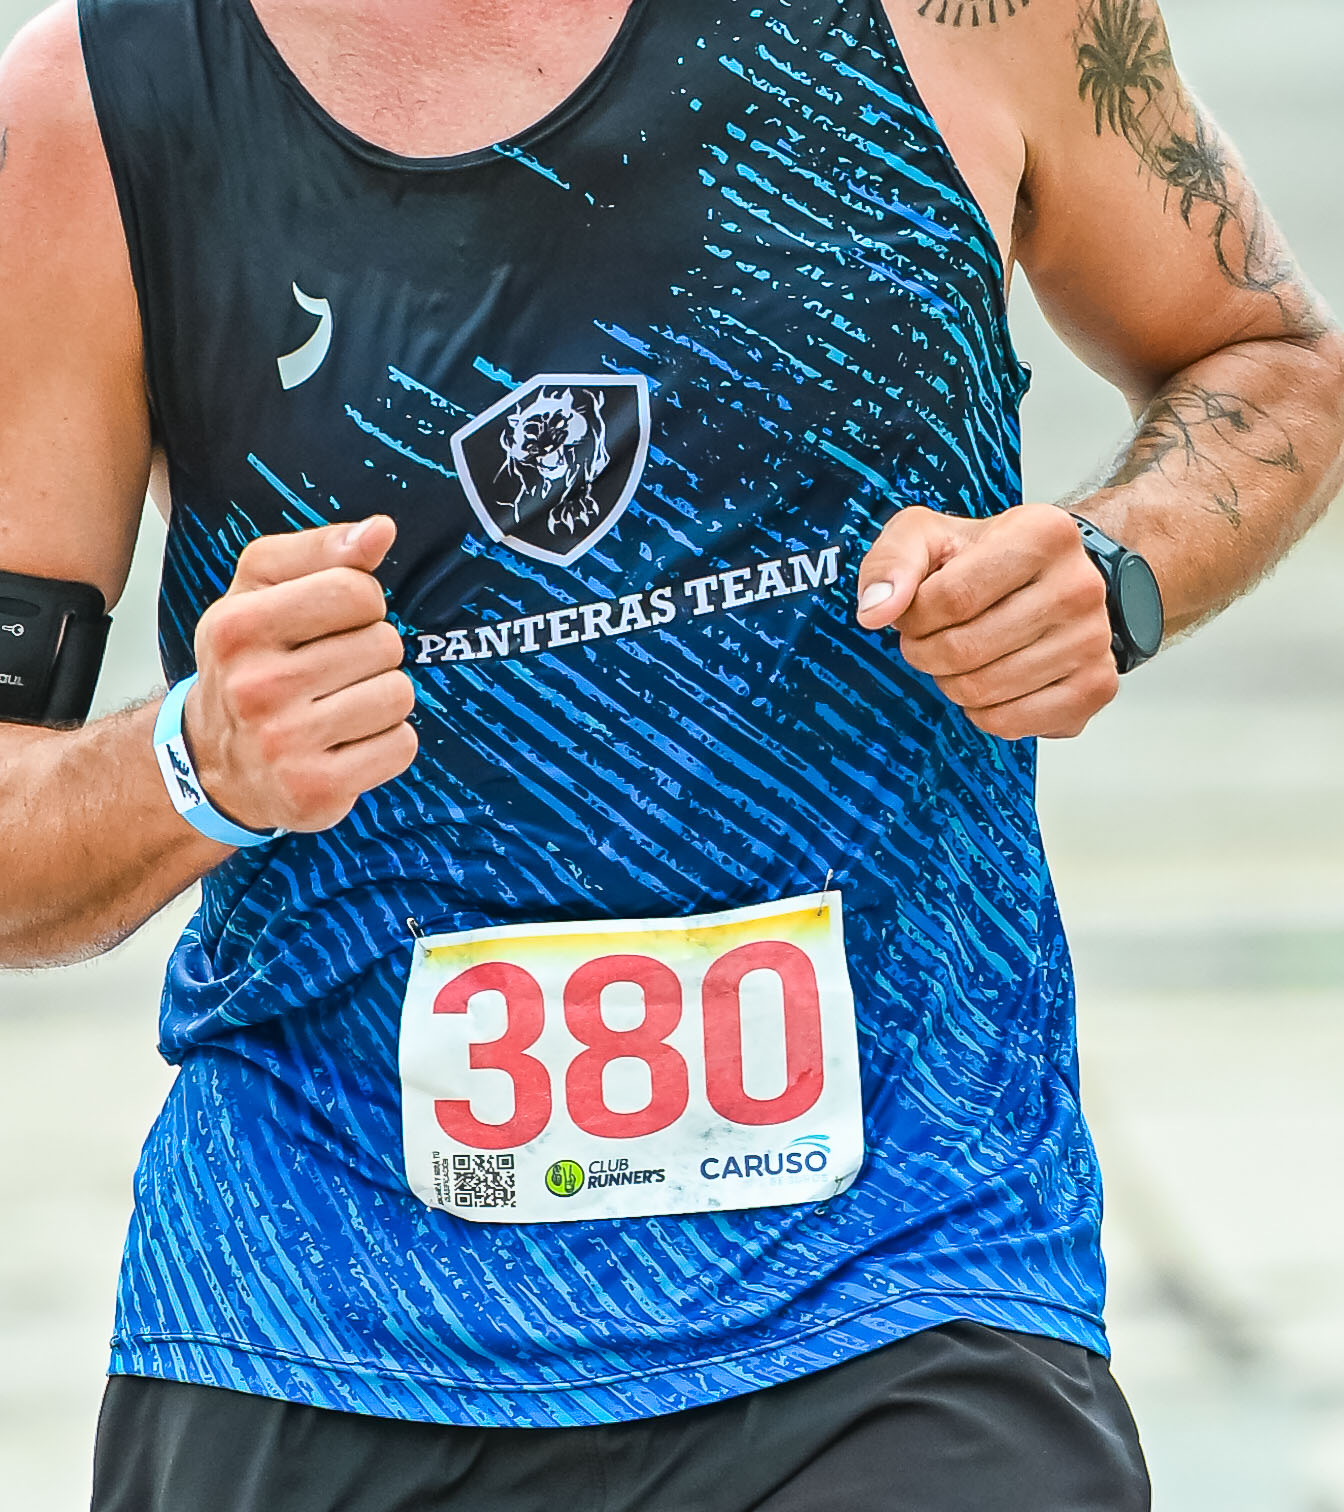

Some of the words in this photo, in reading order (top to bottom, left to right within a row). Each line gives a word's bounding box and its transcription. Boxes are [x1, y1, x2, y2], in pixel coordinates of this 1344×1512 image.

[415, 586, 677, 665] PANTERAS
[684, 545, 841, 618] TEAM
[432, 940, 824, 1150] 380
[587, 1168, 666, 1189] RUNNER'S
[588, 1158, 629, 1174] CLUB
[700, 1150, 827, 1180] CARUSO
